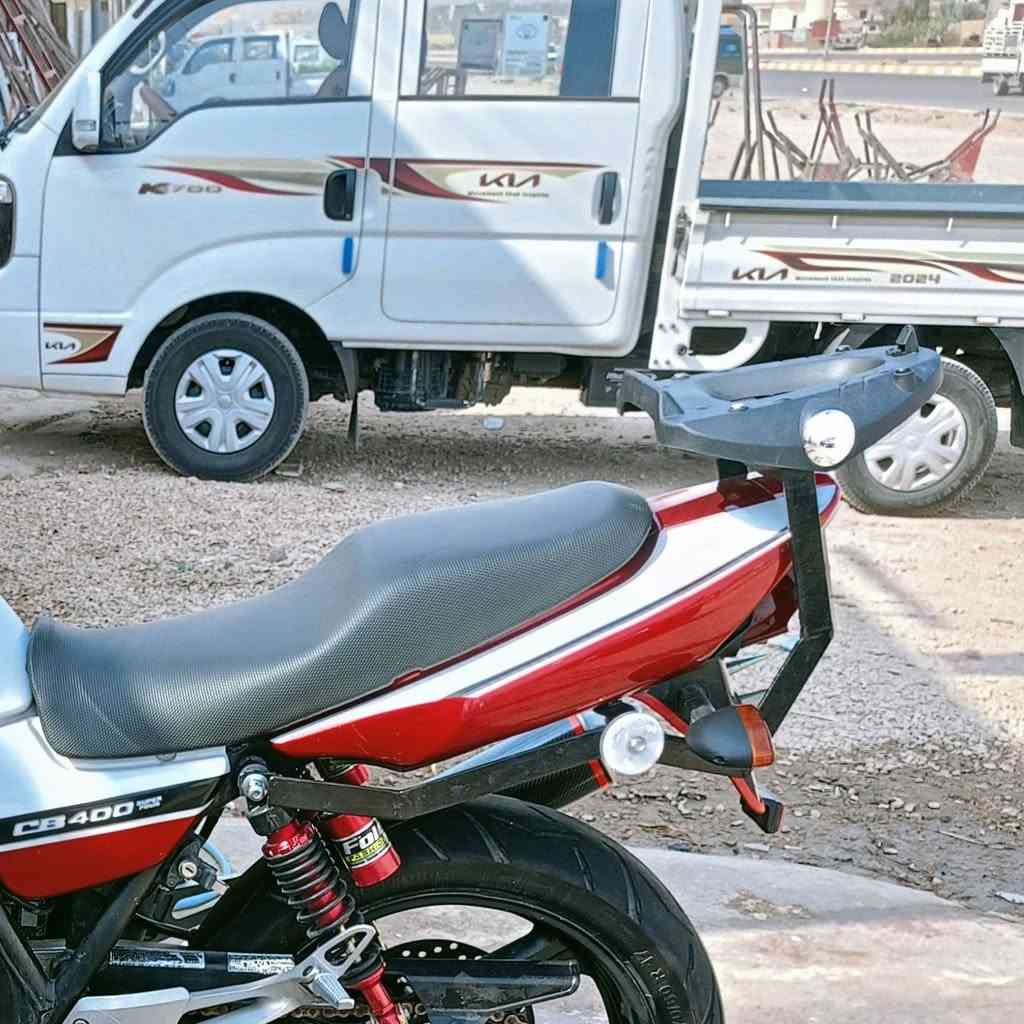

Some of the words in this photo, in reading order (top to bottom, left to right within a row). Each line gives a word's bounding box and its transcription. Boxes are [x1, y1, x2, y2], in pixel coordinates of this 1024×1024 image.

[479, 173, 540, 188] KIA
[732, 267, 788, 281] KIA
[890, 273, 941, 284] 2024
[45, 342, 76, 350] KIA
